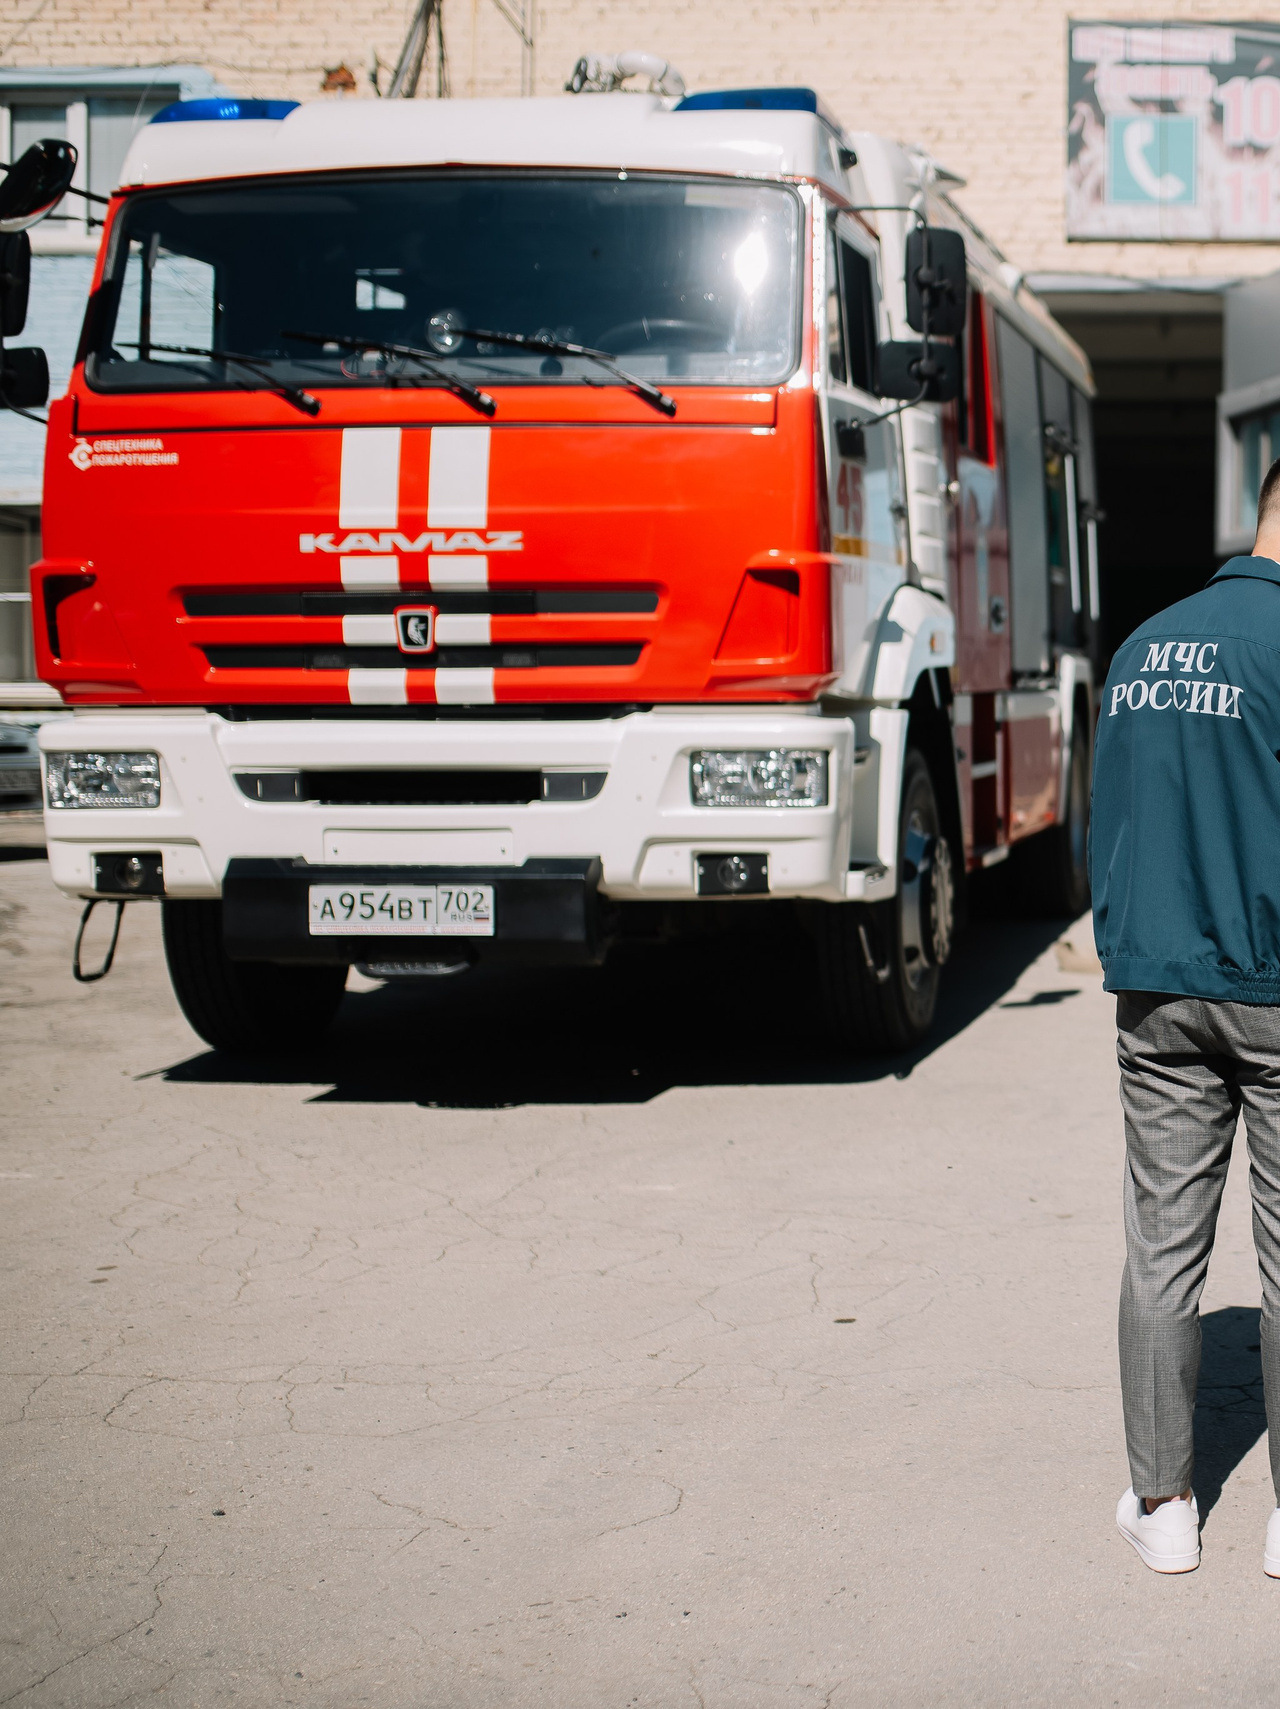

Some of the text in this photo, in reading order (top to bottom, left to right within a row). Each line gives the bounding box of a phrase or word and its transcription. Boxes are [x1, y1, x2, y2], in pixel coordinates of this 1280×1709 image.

[93, 439, 163, 453] СПЕЦТЕХНИКА
[91, 452, 179, 466] ПОЖАРОТУШЕНИЯ
[299, 531, 523, 553] KAMAZ
[1140, 641, 1219, 674] МЧС
[1109, 679, 1244, 719] РОССИИ
[441, 891, 484, 913] 702
